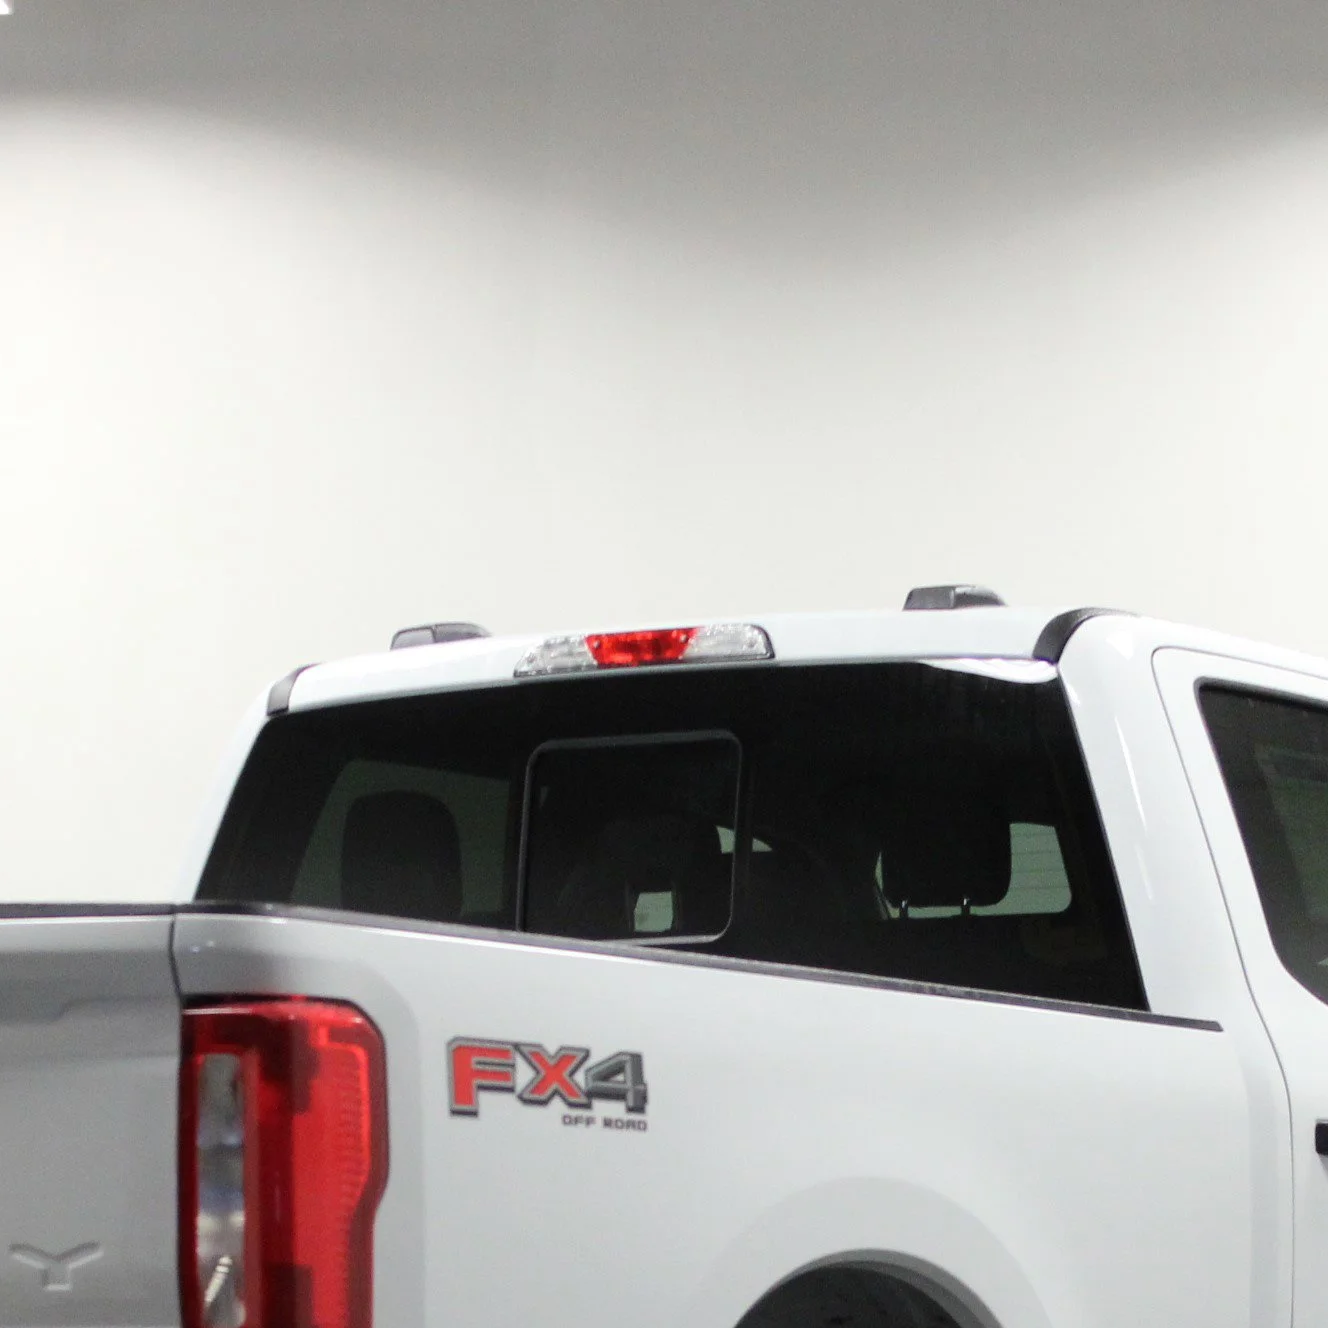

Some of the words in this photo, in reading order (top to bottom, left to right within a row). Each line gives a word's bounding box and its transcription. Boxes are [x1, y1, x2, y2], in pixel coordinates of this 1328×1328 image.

[447, 1036, 648, 1118] FX4
[561, 1113, 596, 1128] OFF
[602, 1116, 648, 1132] ROAD
